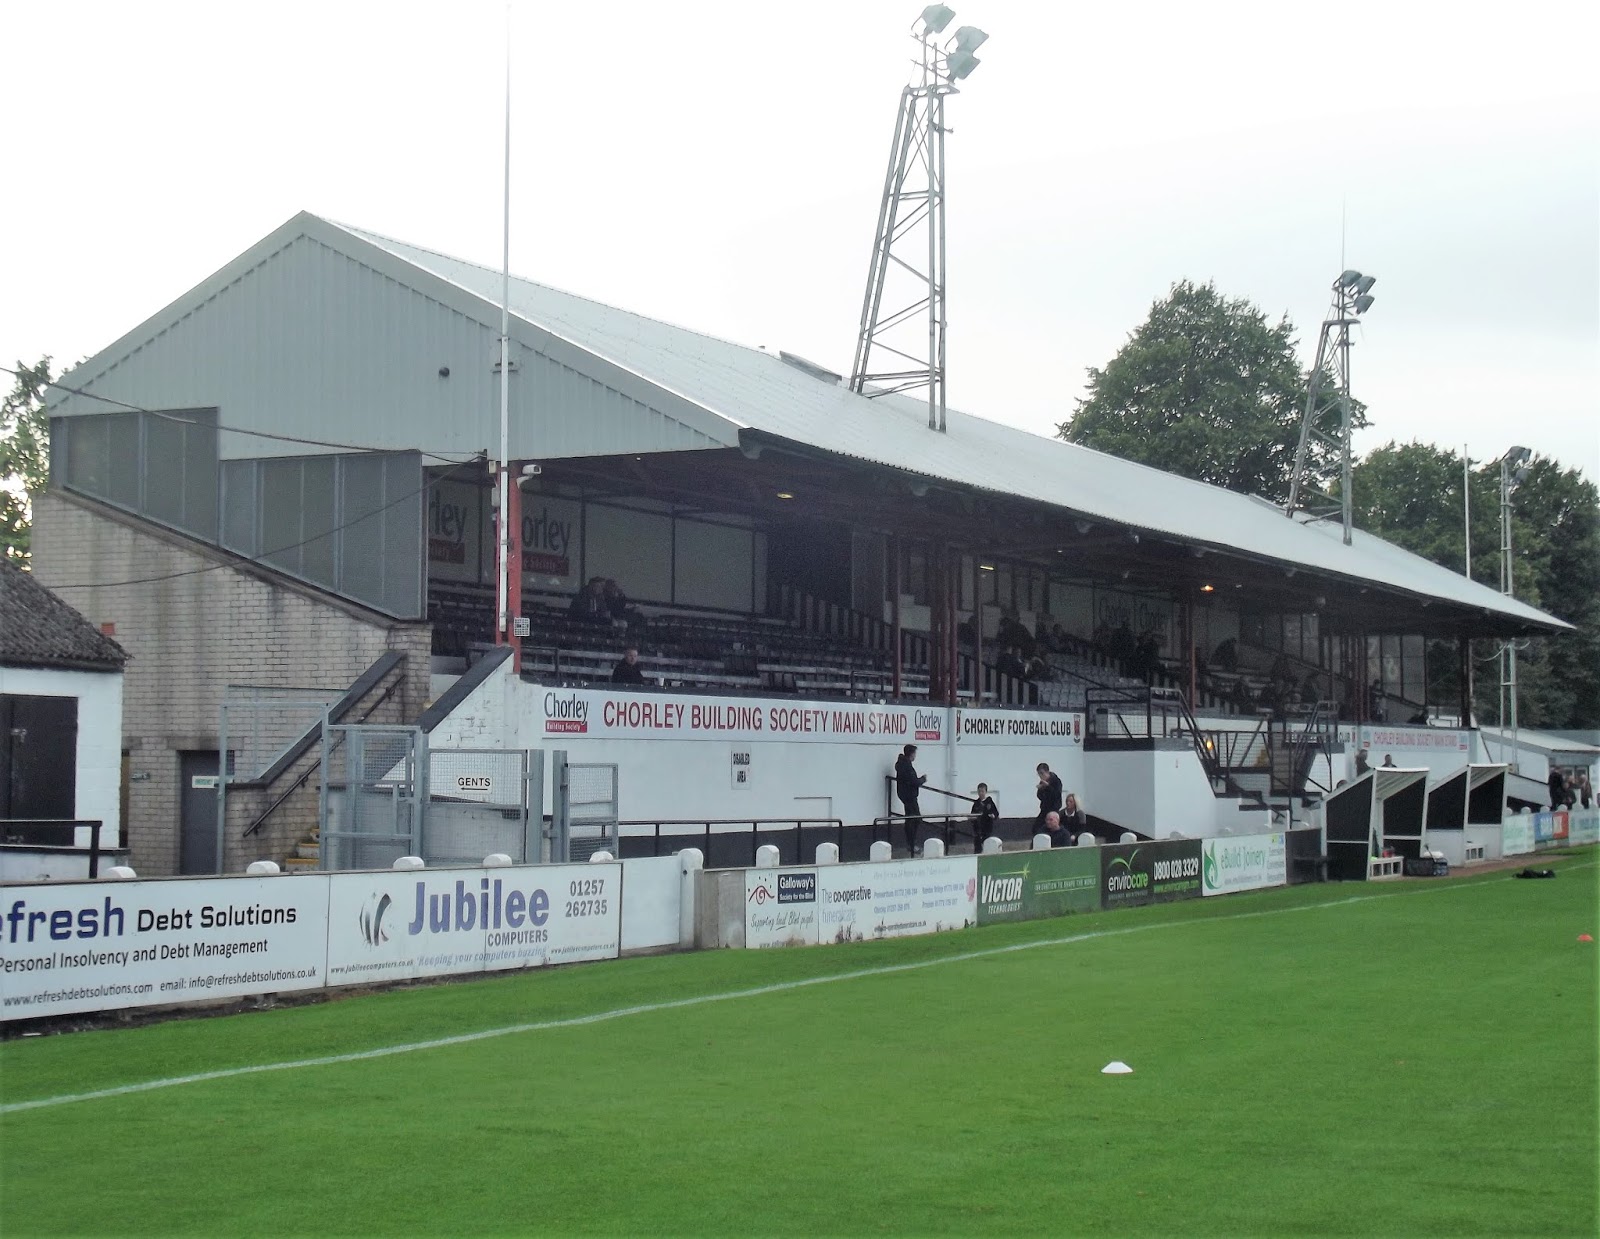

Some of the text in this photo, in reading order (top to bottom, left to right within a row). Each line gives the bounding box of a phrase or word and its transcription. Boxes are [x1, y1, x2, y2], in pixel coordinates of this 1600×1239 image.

[544, 691, 589, 724] Chorley
[604, 701, 908, 735] CHORLEY BUILDING SOCIETY MAIN STAND
[914, 709, 942, 732] Chorley
[964, 718, 1071, 736] CHORLEY FOOTBALL CLUB
[457, 777, 491, 787] GENTS
[1154, 857, 1199, 881] 0800 028 3329
[570, 880, 605, 897] 01257
[780, 876, 815, 891] Galloway's
[981, 875, 1023, 904] VICTOR
[1108, 872, 1149, 892] envirocare
[822, 886, 871, 905] The co-operative
[408, 878, 550, 936] Jubilee
[565, 899, 608, 918] 262735
[988, 903, 1020, 915] TECHNOLOGIES
[137, 908, 193, 933] Debt
[200, 903, 297, 929] Solutions
[487, 929, 548, 947] COMPUTERS
[60, 949, 129, 967] Insolvency
[132, 945, 157, 963] and
[160, 943, 190, 961] Debt
[193, 939, 269, 959] Management
[455, 952, 473, 965] your
[473, 948, 516, 963] computers
[330, 959, 414, 975] www.jubileecomputers.co.uk
[3, 966, 317, 1007] www.refreshdebtsolutions.com email: info@refreshdebtsolutions.co.uk
